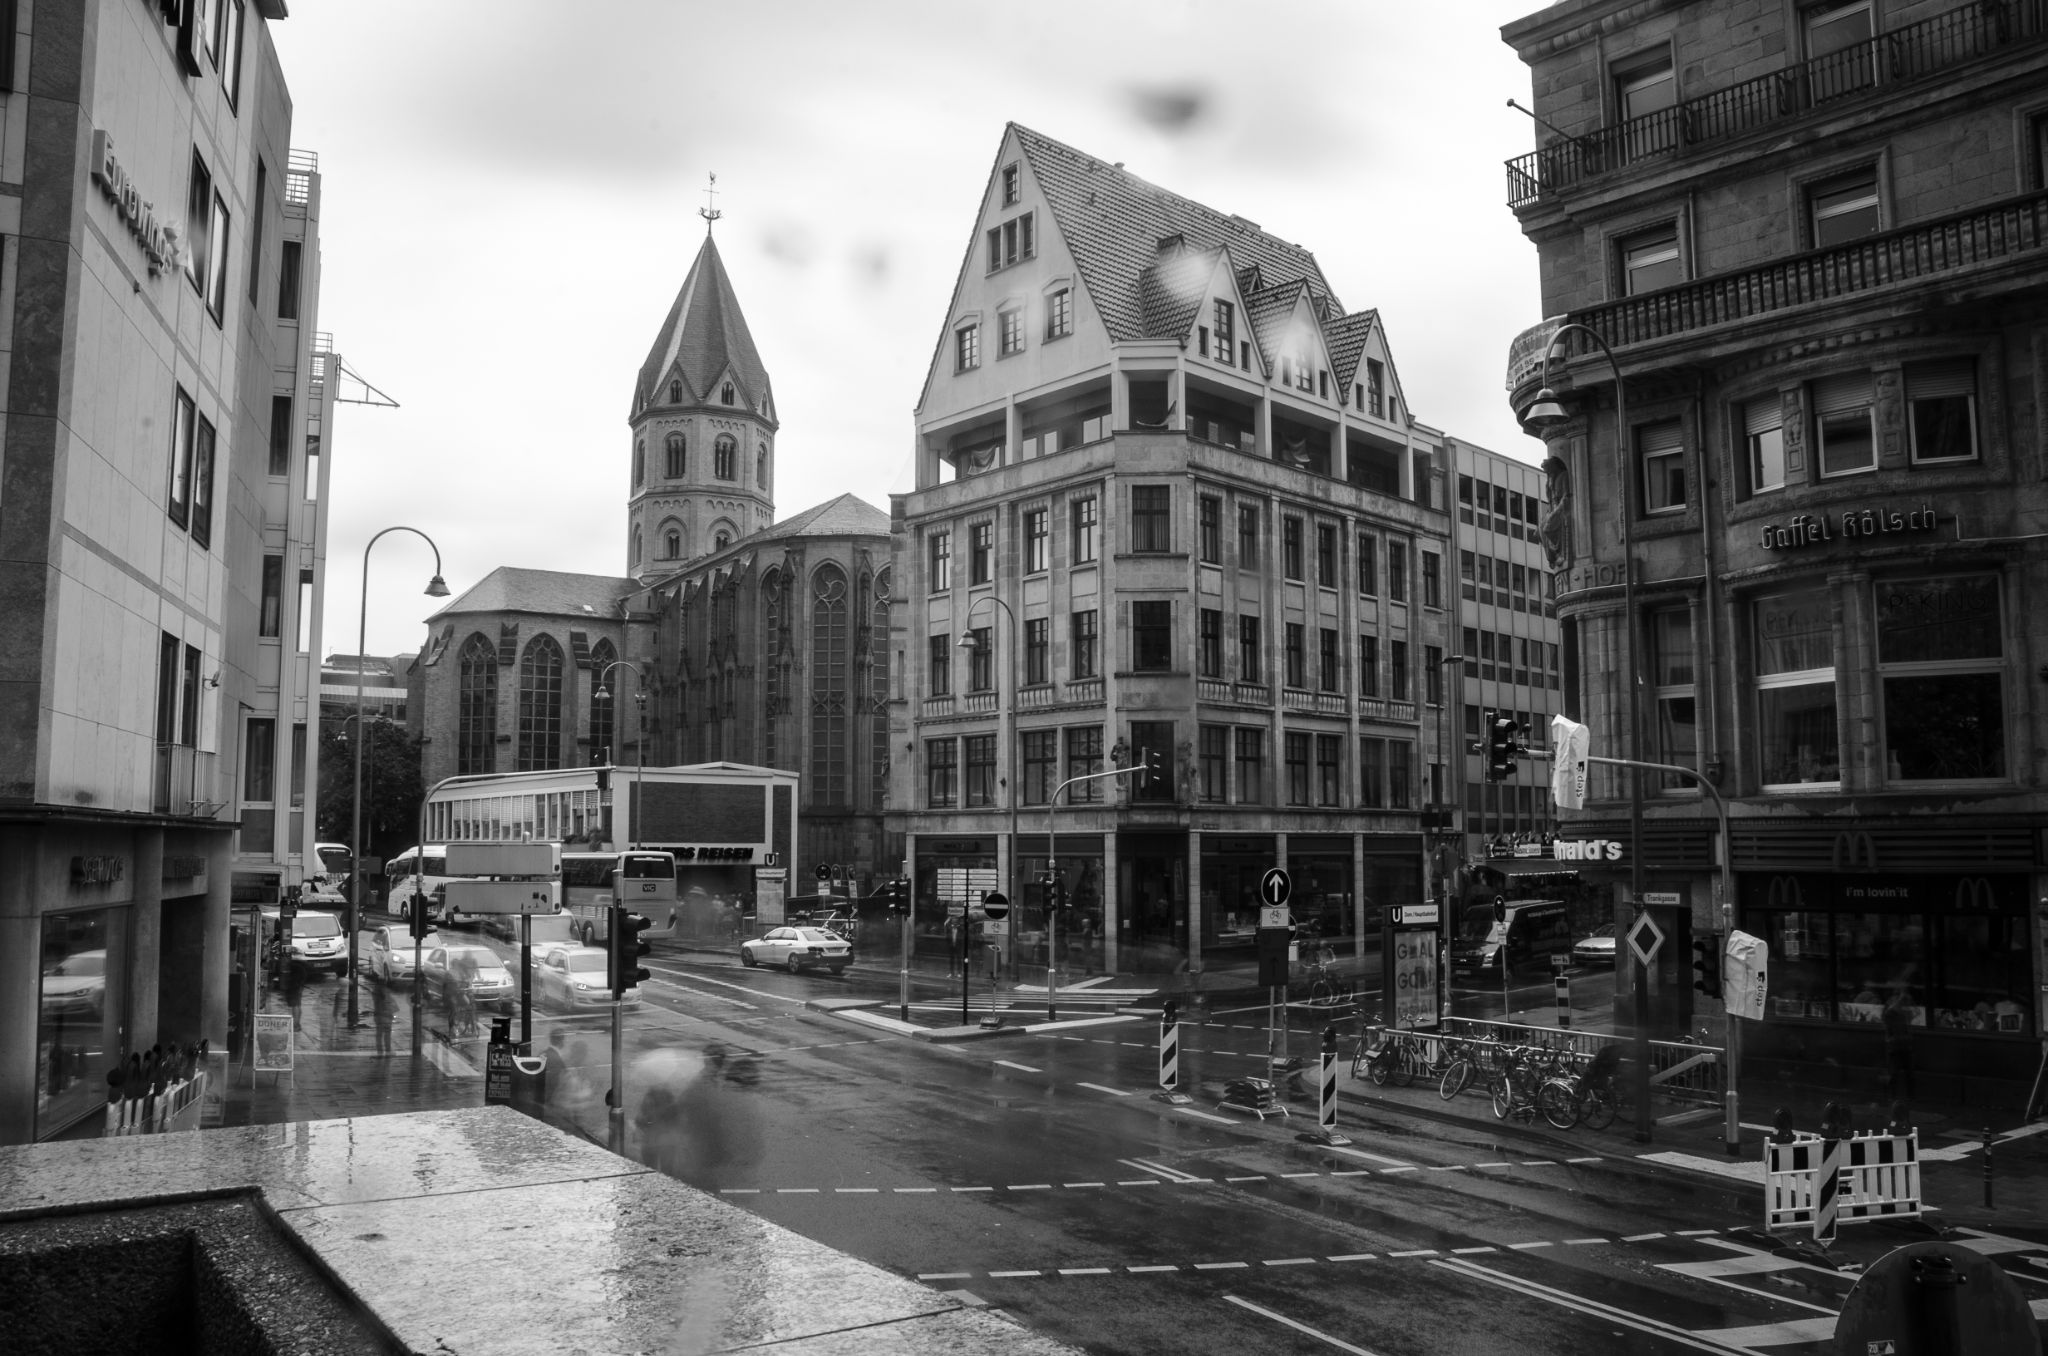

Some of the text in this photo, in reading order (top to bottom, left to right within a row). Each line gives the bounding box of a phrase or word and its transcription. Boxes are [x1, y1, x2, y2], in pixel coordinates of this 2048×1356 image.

[93, 129, 173, 274] Eurowings
[1761, 504, 1937, 549] Gaffel Kölsch
[1889, 591, 1986, 614] PEKING
[697, 847, 754, 860] REISEN
[1846, 887, 1864, 897] I'm
[1392, 907, 1402, 922] U
